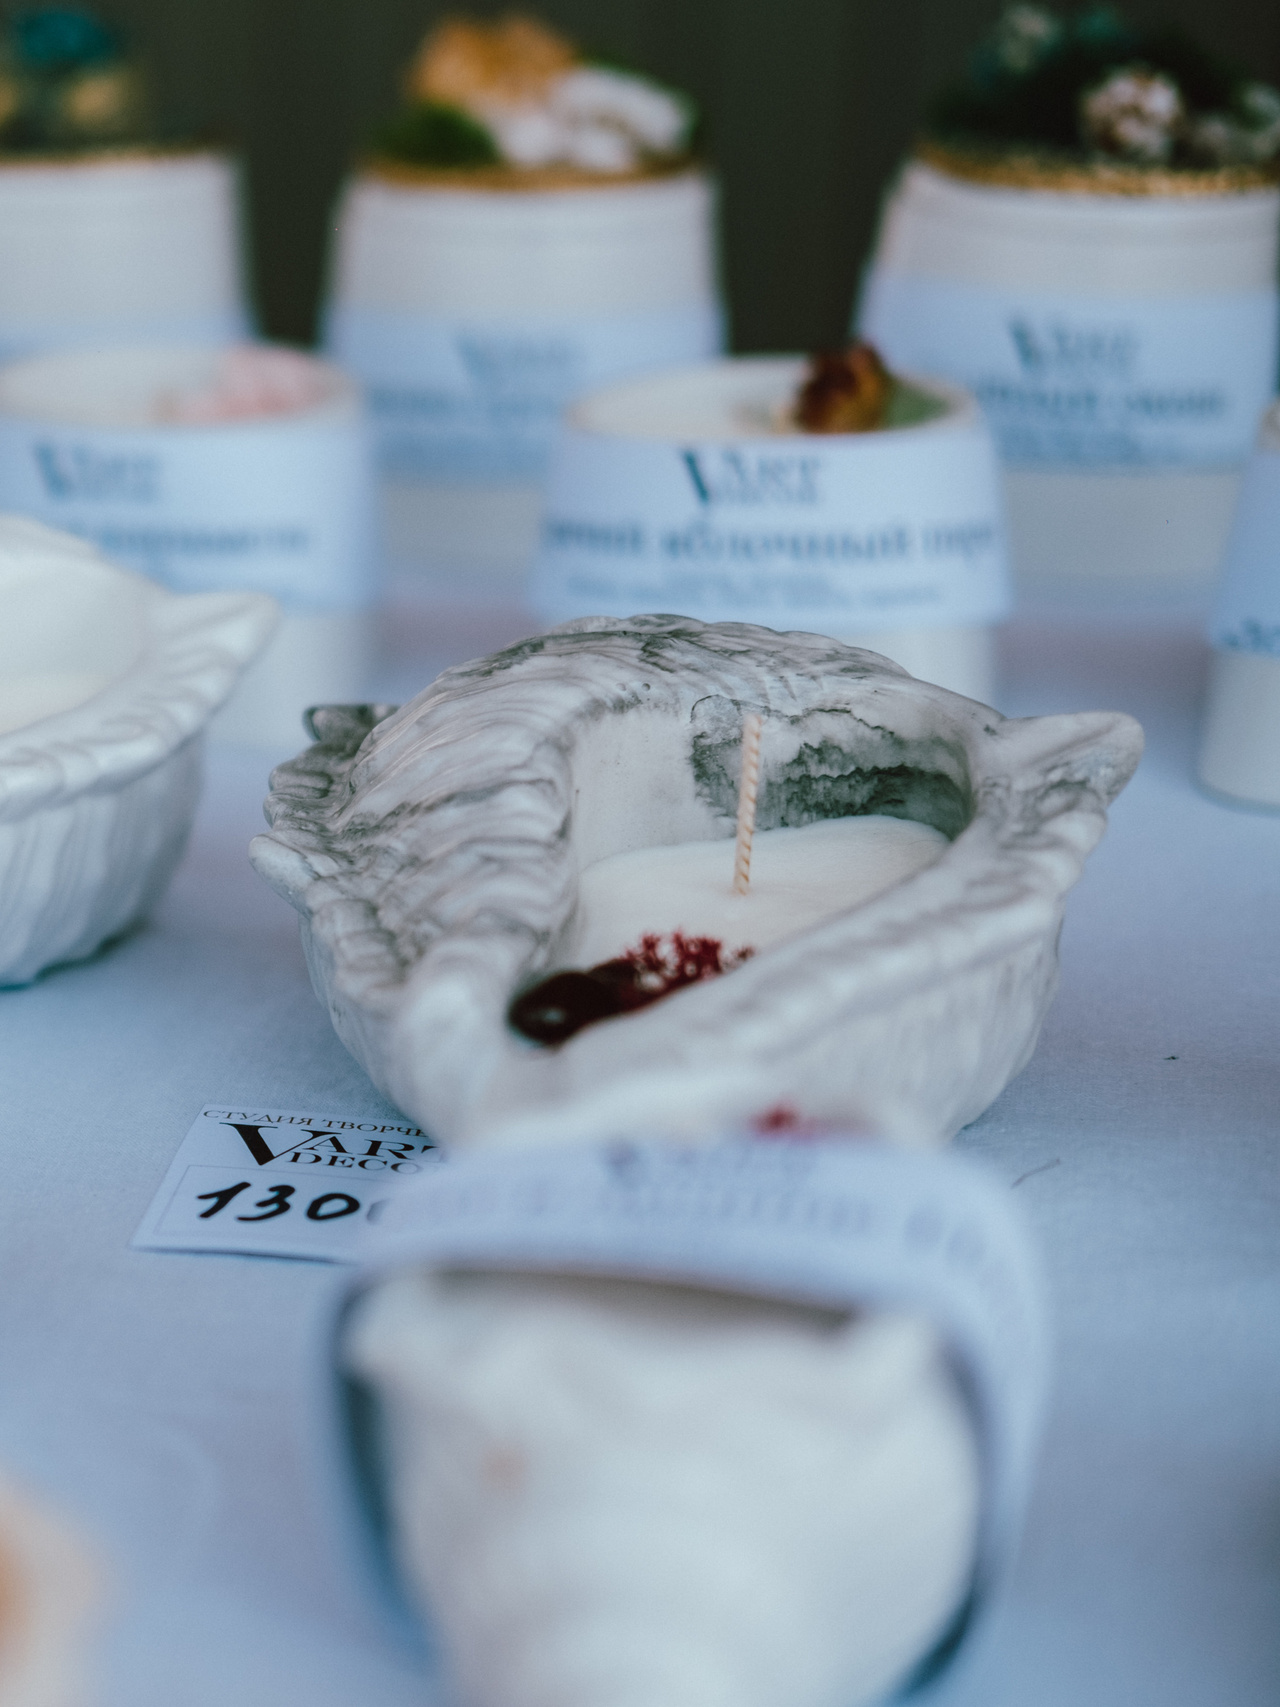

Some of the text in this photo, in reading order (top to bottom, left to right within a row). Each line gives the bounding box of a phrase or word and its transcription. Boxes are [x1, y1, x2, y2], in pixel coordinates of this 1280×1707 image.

[203, 1109, 429, 1139] СТУДИЯ ТВОРЧЕ
[285, 1151, 422, 1176] DECO
[196, 1181, 384, 1224] 130
